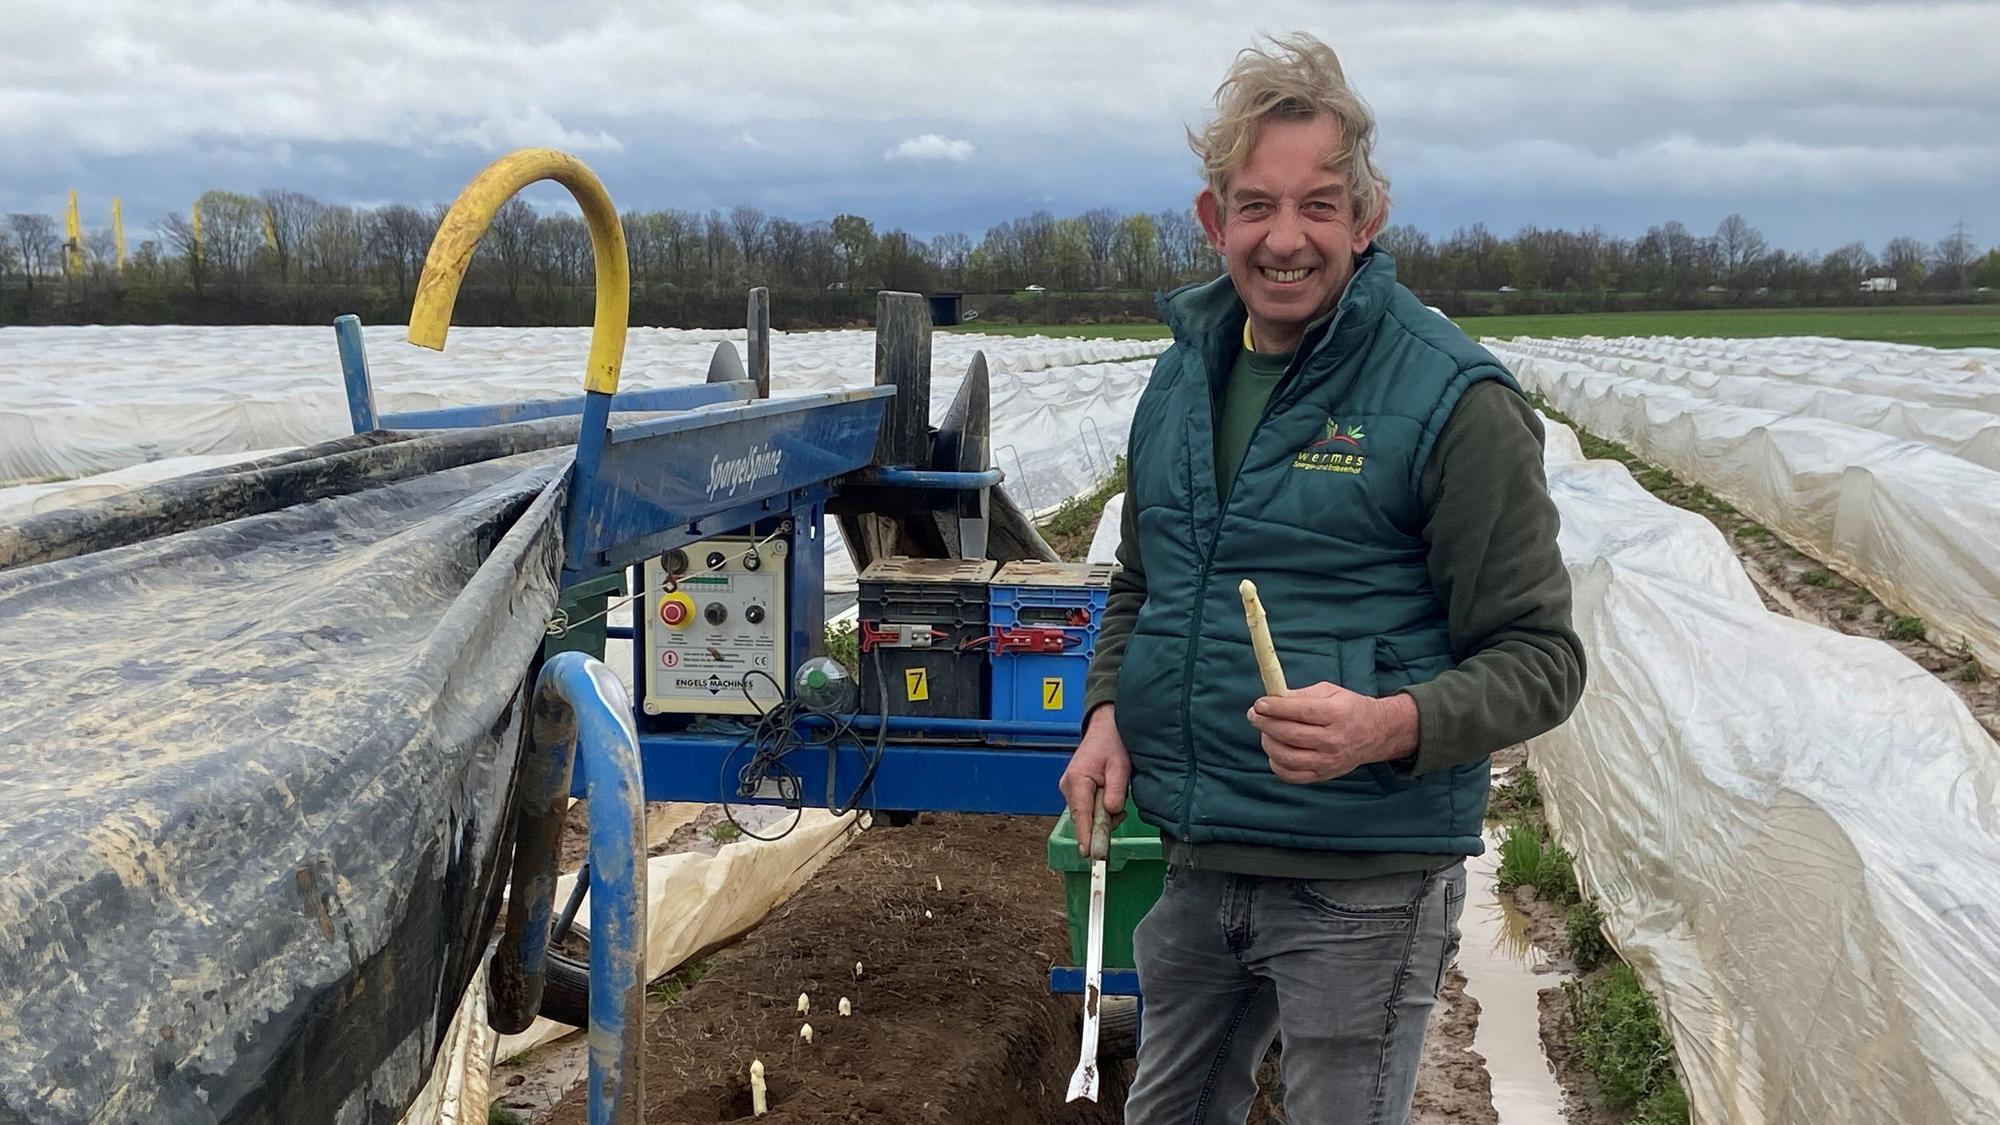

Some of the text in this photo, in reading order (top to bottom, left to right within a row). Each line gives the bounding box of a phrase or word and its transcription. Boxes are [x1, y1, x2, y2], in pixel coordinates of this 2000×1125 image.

[1298, 452, 1365, 466] wermes
[706, 442, 782, 502] SpargelSpinne
[754, 656, 767, 666] CE
[675, 679, 754, 688] ENGELS MACHINES
[909, 671, 924, 695] 7
[1045, 681, 1061, 704] 7
